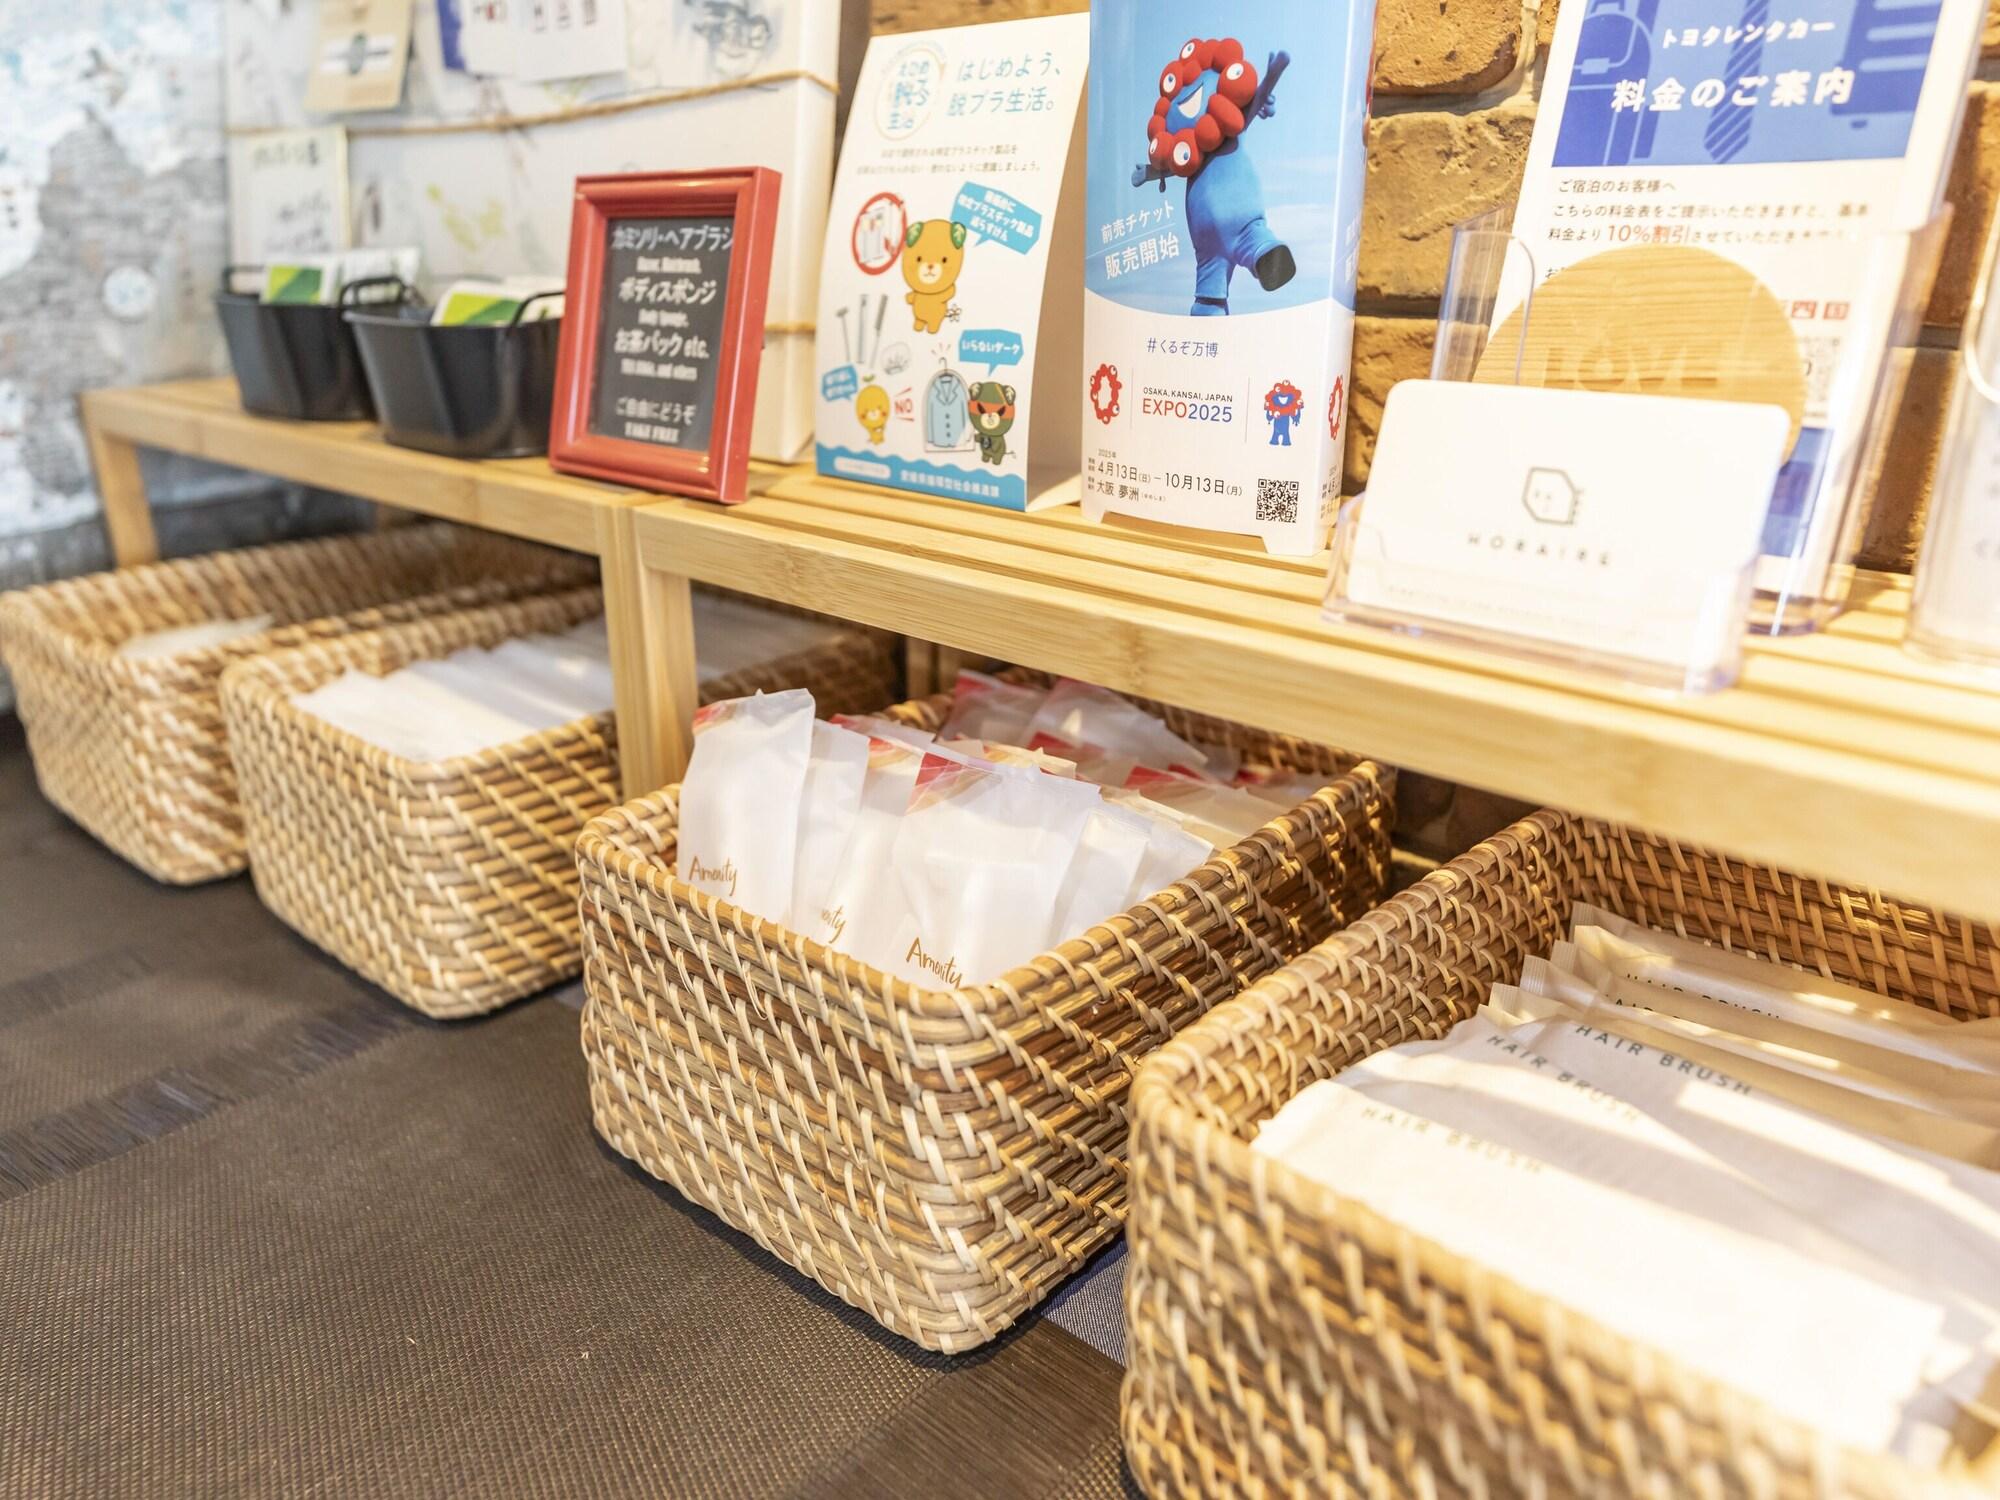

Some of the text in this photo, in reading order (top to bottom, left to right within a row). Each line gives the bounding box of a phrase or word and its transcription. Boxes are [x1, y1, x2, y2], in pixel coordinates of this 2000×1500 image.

[1662, 18, 1836, 50] トヨタレンタカー
[958, 52, 1061, 81] はじめよう、
[947, 86, 1055, 117] 脱プラ生活。
[1611, 67, 1856, 113] 料金のご案内
[1558, 178, 1676, 194] ご宿泊のお客様へ
[1100, 200, 1175, 244] 前売チケット
[1104, 231, 1180, 280] 販売開始
[1147, 337, 1219, 358] #くるぞ万博
[895, 399, 914, 414] NO
[1142, 398, 1233, 423] EXPO2025
[1204, 392, 1233, 403] JAPAN
[1096, 481, 1114, 497] 大阪
[1575, 1024, 1753, 1096] HAIR BRUSH
[1486, 1034, 1640, 1122] HAIR BRUSH
[1361, 1106, 1430, 1134] HAIR
